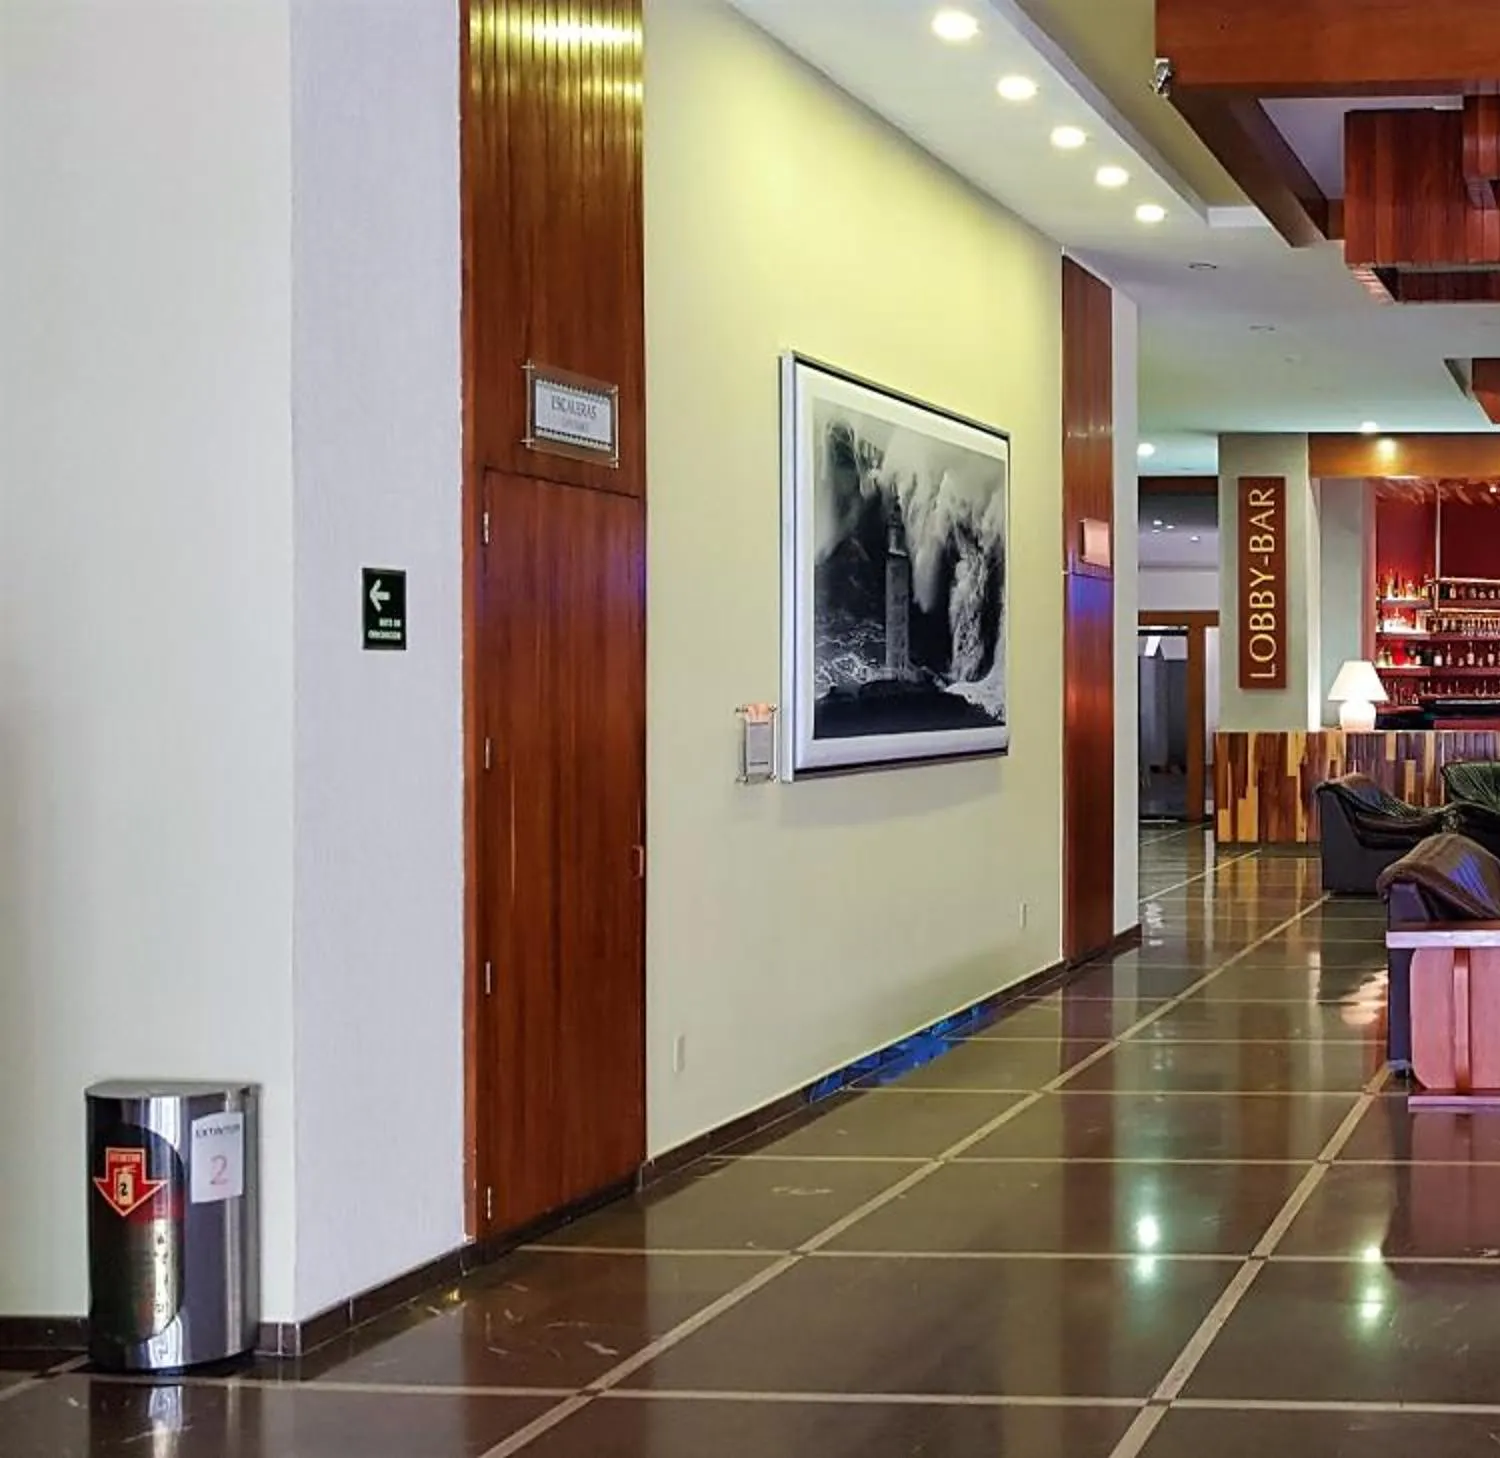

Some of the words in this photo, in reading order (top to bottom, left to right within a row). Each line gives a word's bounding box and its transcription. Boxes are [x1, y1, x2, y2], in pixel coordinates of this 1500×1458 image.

[1249, 487, 1277, 679] LOBBY-BAR
[209, 1154, 229, 1186] 2
[120, 1182, 128, 1196] 2
